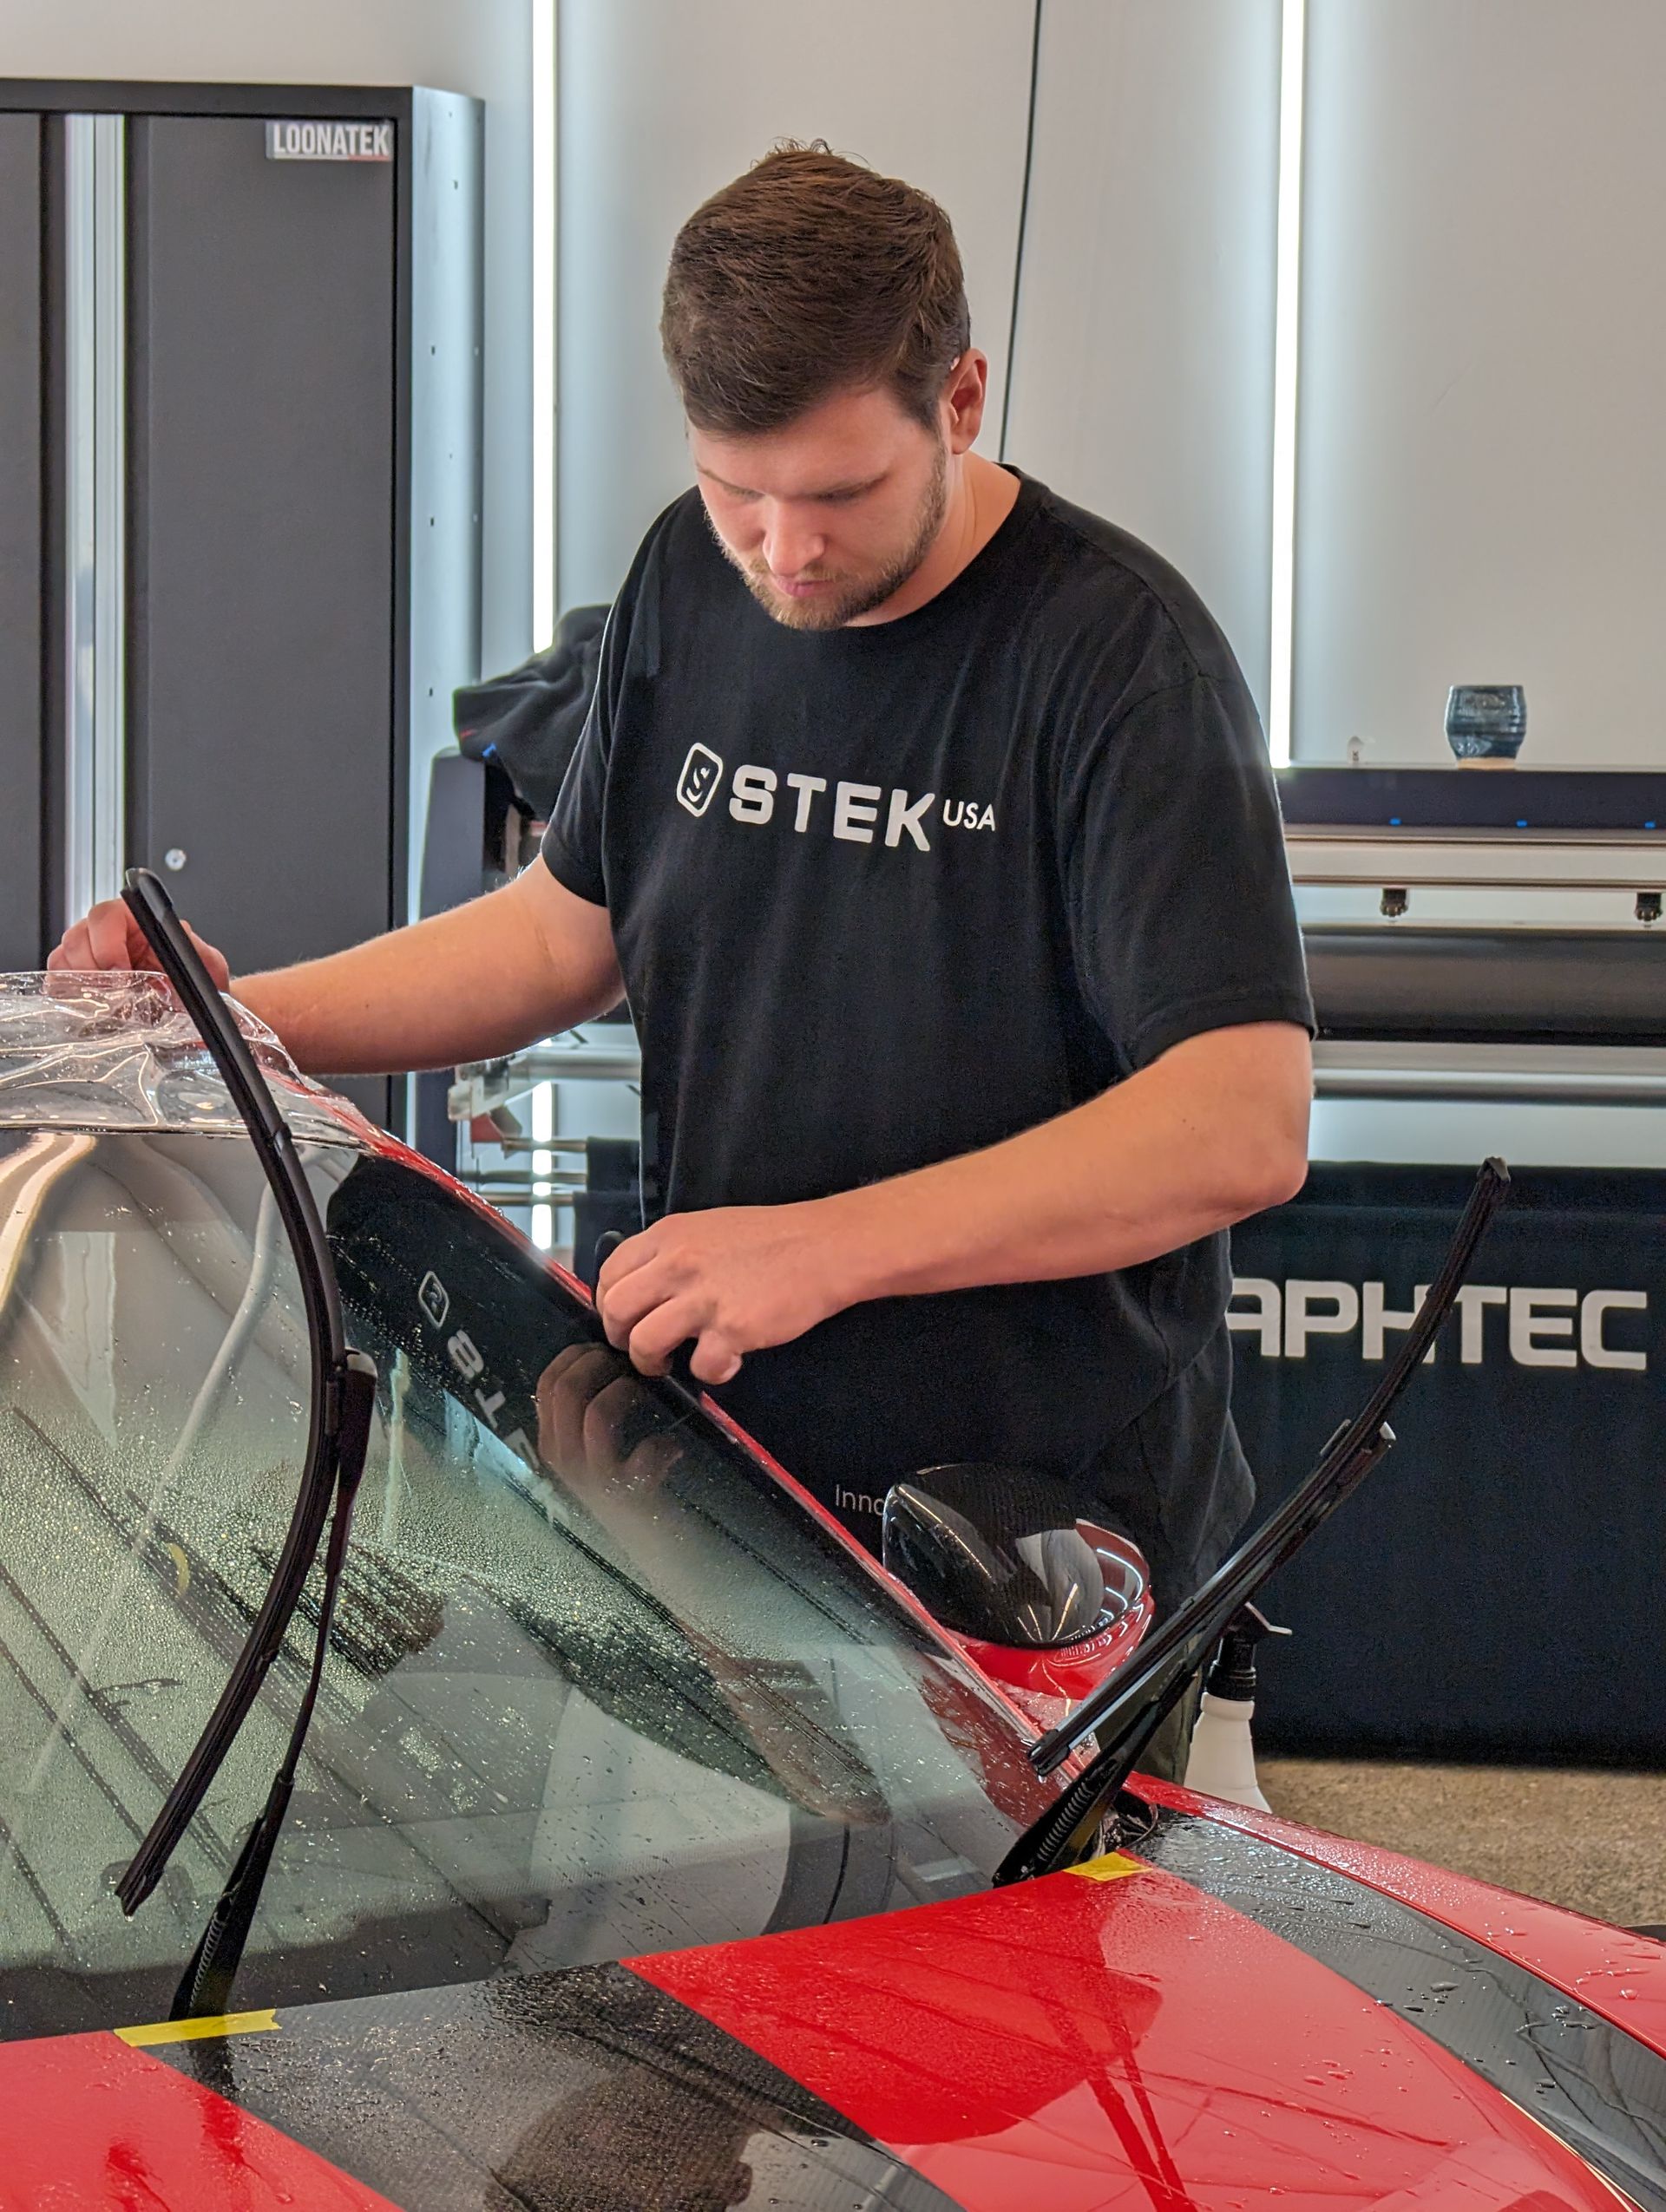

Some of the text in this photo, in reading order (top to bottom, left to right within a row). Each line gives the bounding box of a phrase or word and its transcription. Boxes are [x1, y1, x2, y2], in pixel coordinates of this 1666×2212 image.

[273, 123, 390, 155] LOONATEK
[729, 764, 996, 852] STEK USA
